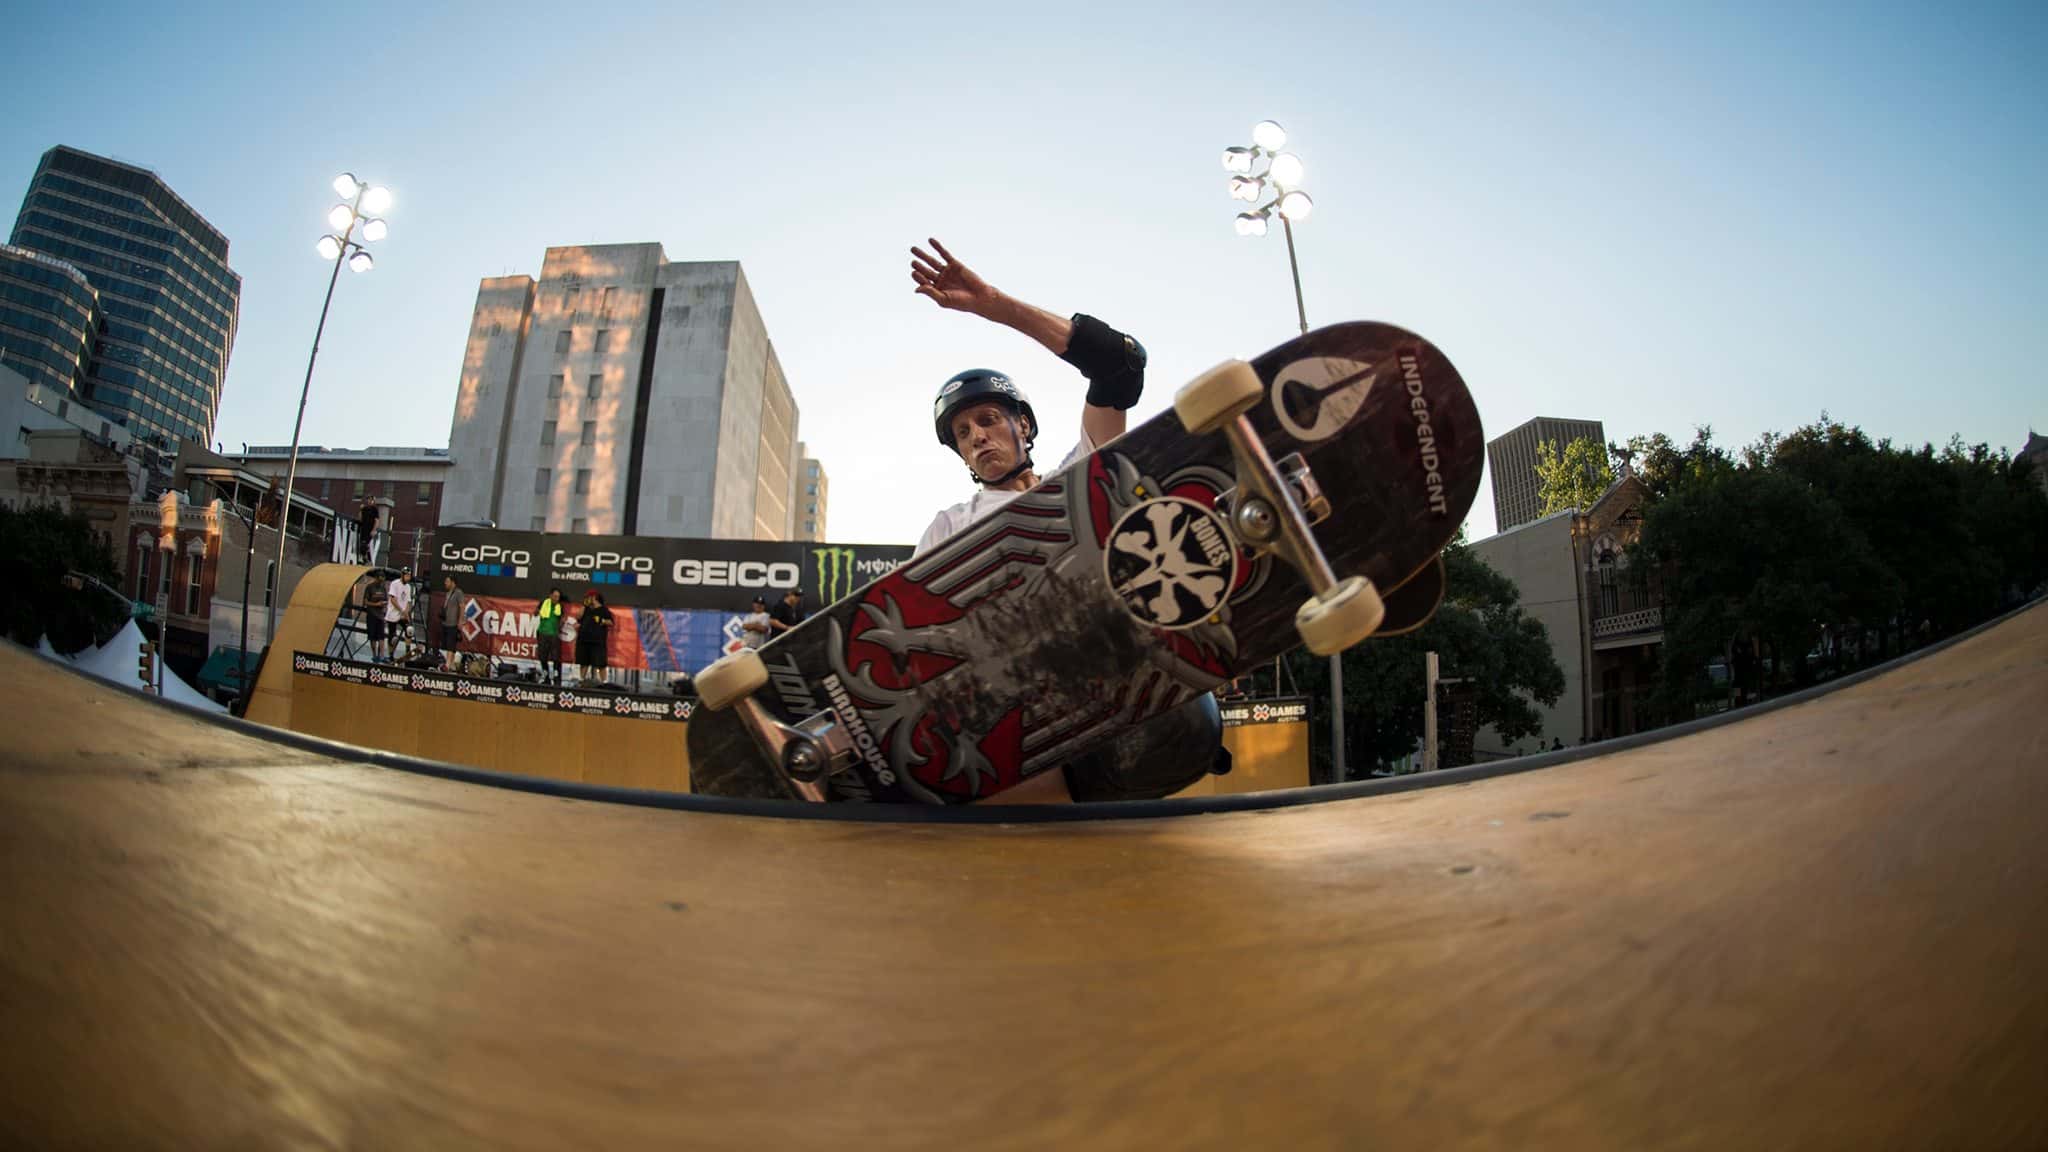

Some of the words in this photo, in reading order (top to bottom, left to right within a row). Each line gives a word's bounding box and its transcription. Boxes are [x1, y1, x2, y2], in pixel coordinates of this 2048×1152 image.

[1400, 355, 1448, 516] INDEPENDENT
[1190, 515, 1230, 567] BONES
[441, 543, 530, 565] GoPro
[551, 550, 653, 572] GoPro
[856, 558, 899, 575] MON
[672, 559, 800, 589] GEICO
[482, 609, 578, 642] GAMS
[500, 641, 538, 657] AUST
[305, 660, 329, 672] GAMES
[342, 666, 368, 679] GAMES
[381, 672, 409, 685] GAMES
[424, 679, 454, 691] GAMES
[470, 684, 502, 697] GAMES
[520, 690, 555, 703] GAMES
[574, 696, 611, 709] GAMES
[631, 701, 670, 714] GAMES
[1270, 705, 1306, 717] GAMES
[821, 673, 896, 787] BIRDHOUSE
